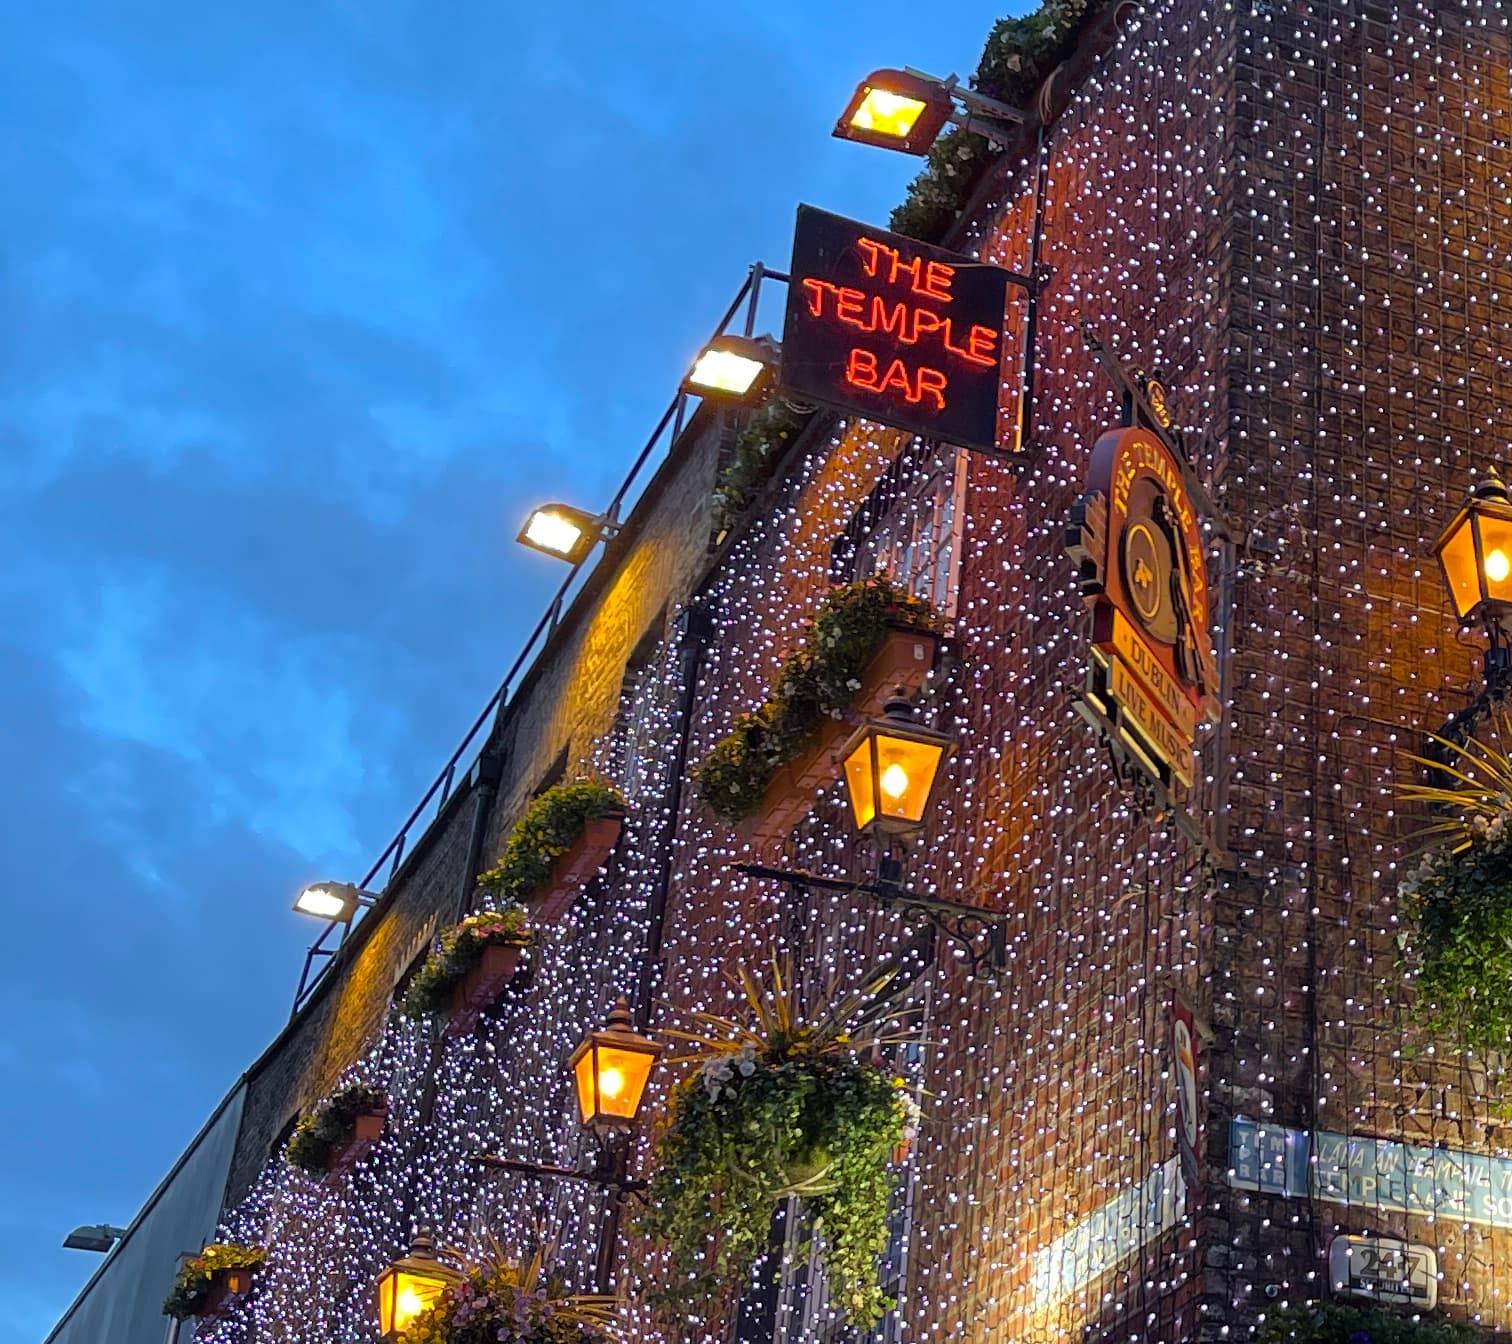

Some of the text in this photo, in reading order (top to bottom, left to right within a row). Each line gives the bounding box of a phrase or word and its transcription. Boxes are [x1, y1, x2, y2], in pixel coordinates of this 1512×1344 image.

[857, 237, 956, 302] THE
[802, 278, 998, 366] TEMPLE
[846, 348, 948, 409] BAR
[1114, 451, 1136, 518] THE
[1132, 441, 1193, 534] TEMPLE
[1188, 543, 1204, 623] BAR
[1131, 637, 1181, 715] DUBLIN
[1119, 673, 1190, 770] LIVE MUSIC
